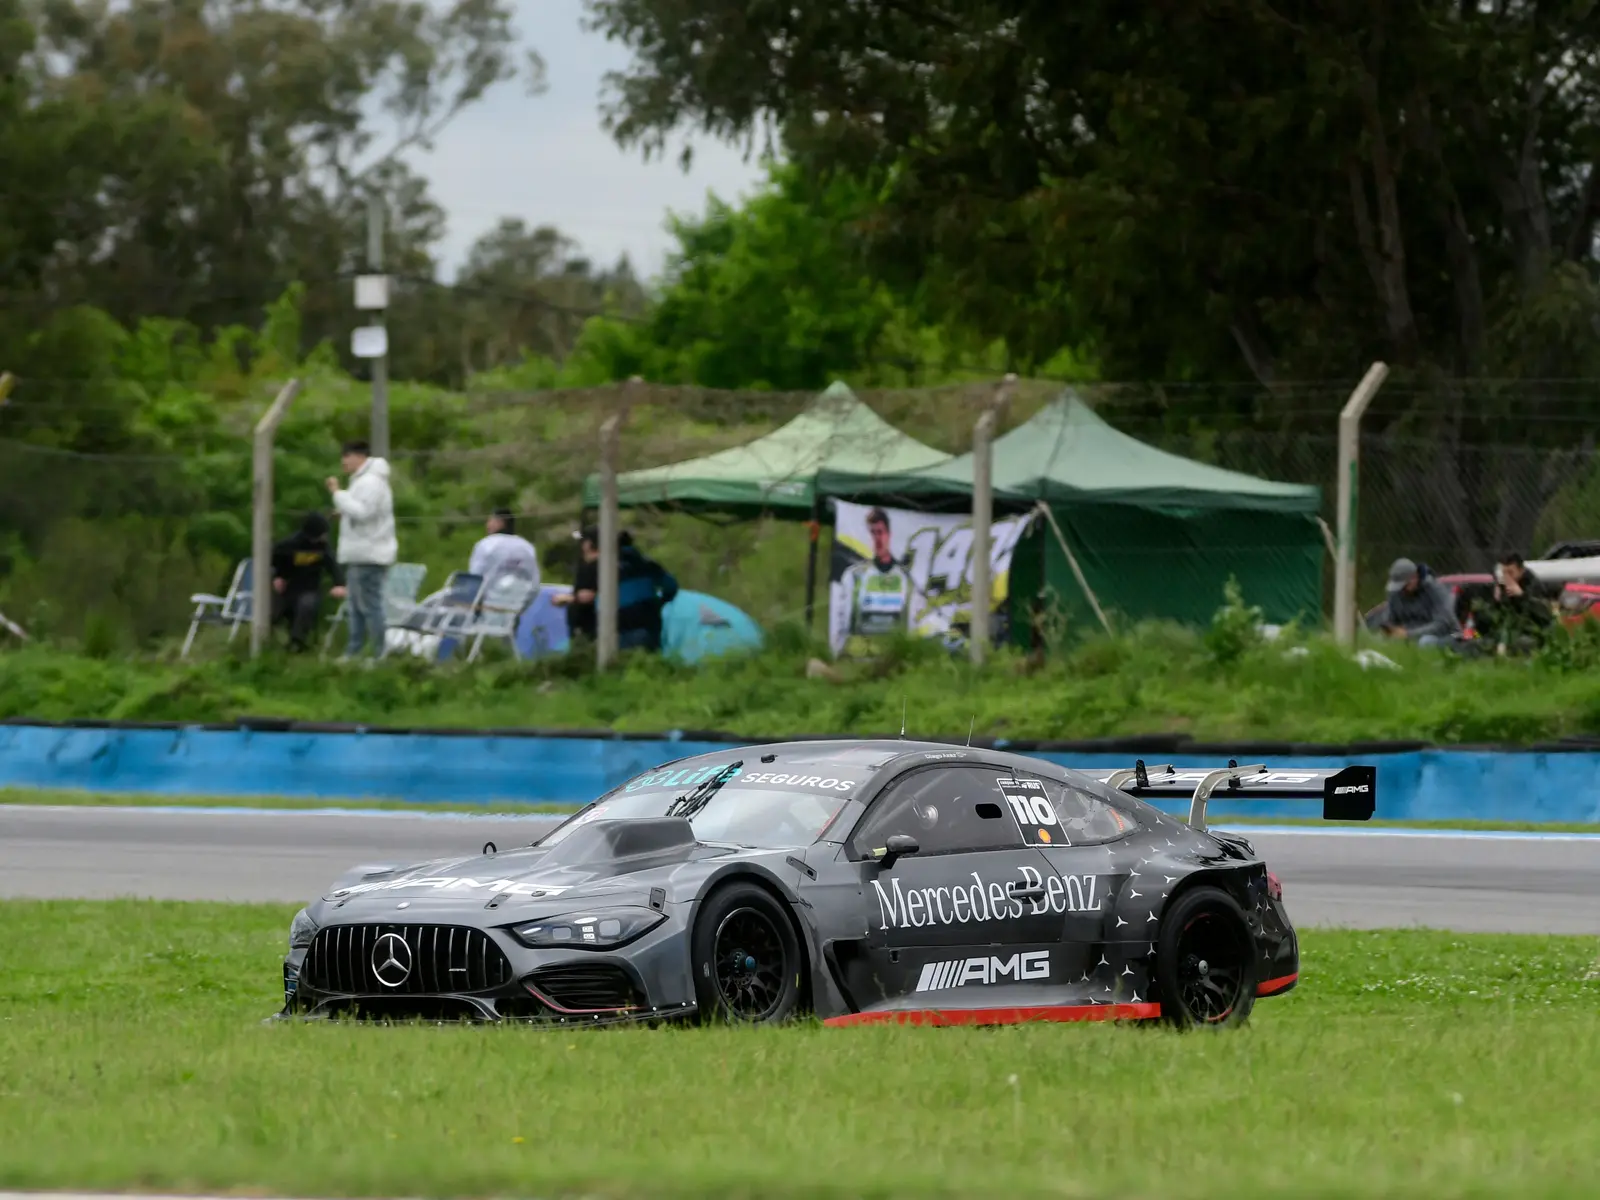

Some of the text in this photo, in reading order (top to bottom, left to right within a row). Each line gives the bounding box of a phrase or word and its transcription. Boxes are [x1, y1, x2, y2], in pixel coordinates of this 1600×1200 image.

[741, 772, 856, 792] SEGUROS
[1006, 795, 1057, 826] 110
[392, 877, 574, 896] AMG
[957, 950, 1050, 986] AMG
